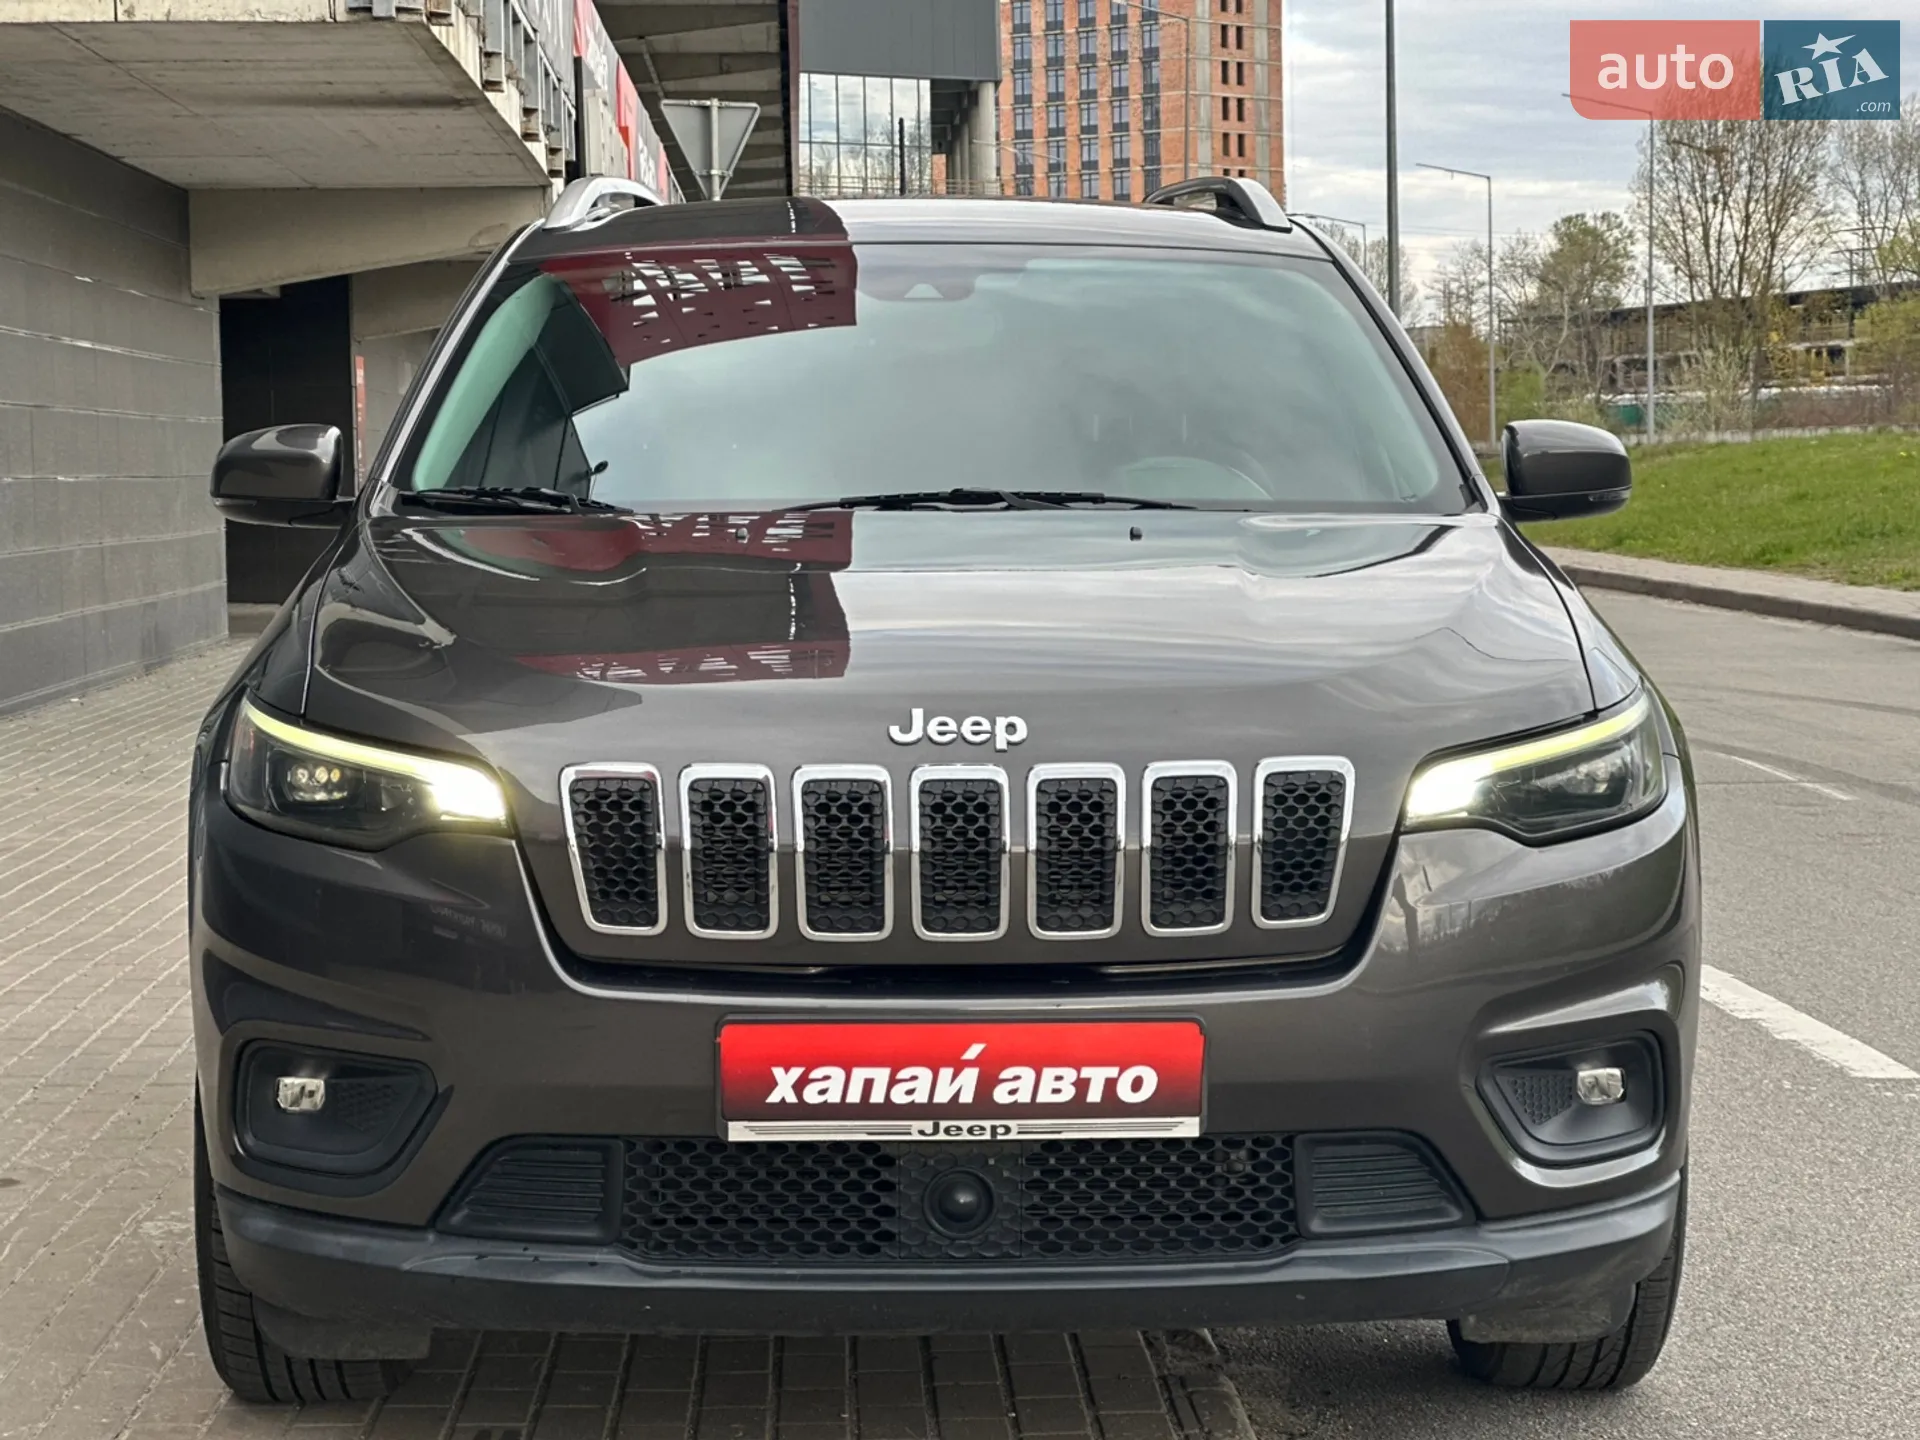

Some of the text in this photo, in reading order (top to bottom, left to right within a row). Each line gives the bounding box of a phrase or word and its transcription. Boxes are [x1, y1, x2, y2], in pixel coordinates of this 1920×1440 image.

[888, 708, 1028, 752] Jeep
[992, 1065, 1159, 1104] авто
[917, 1121, 1013, 1139] Jeep
